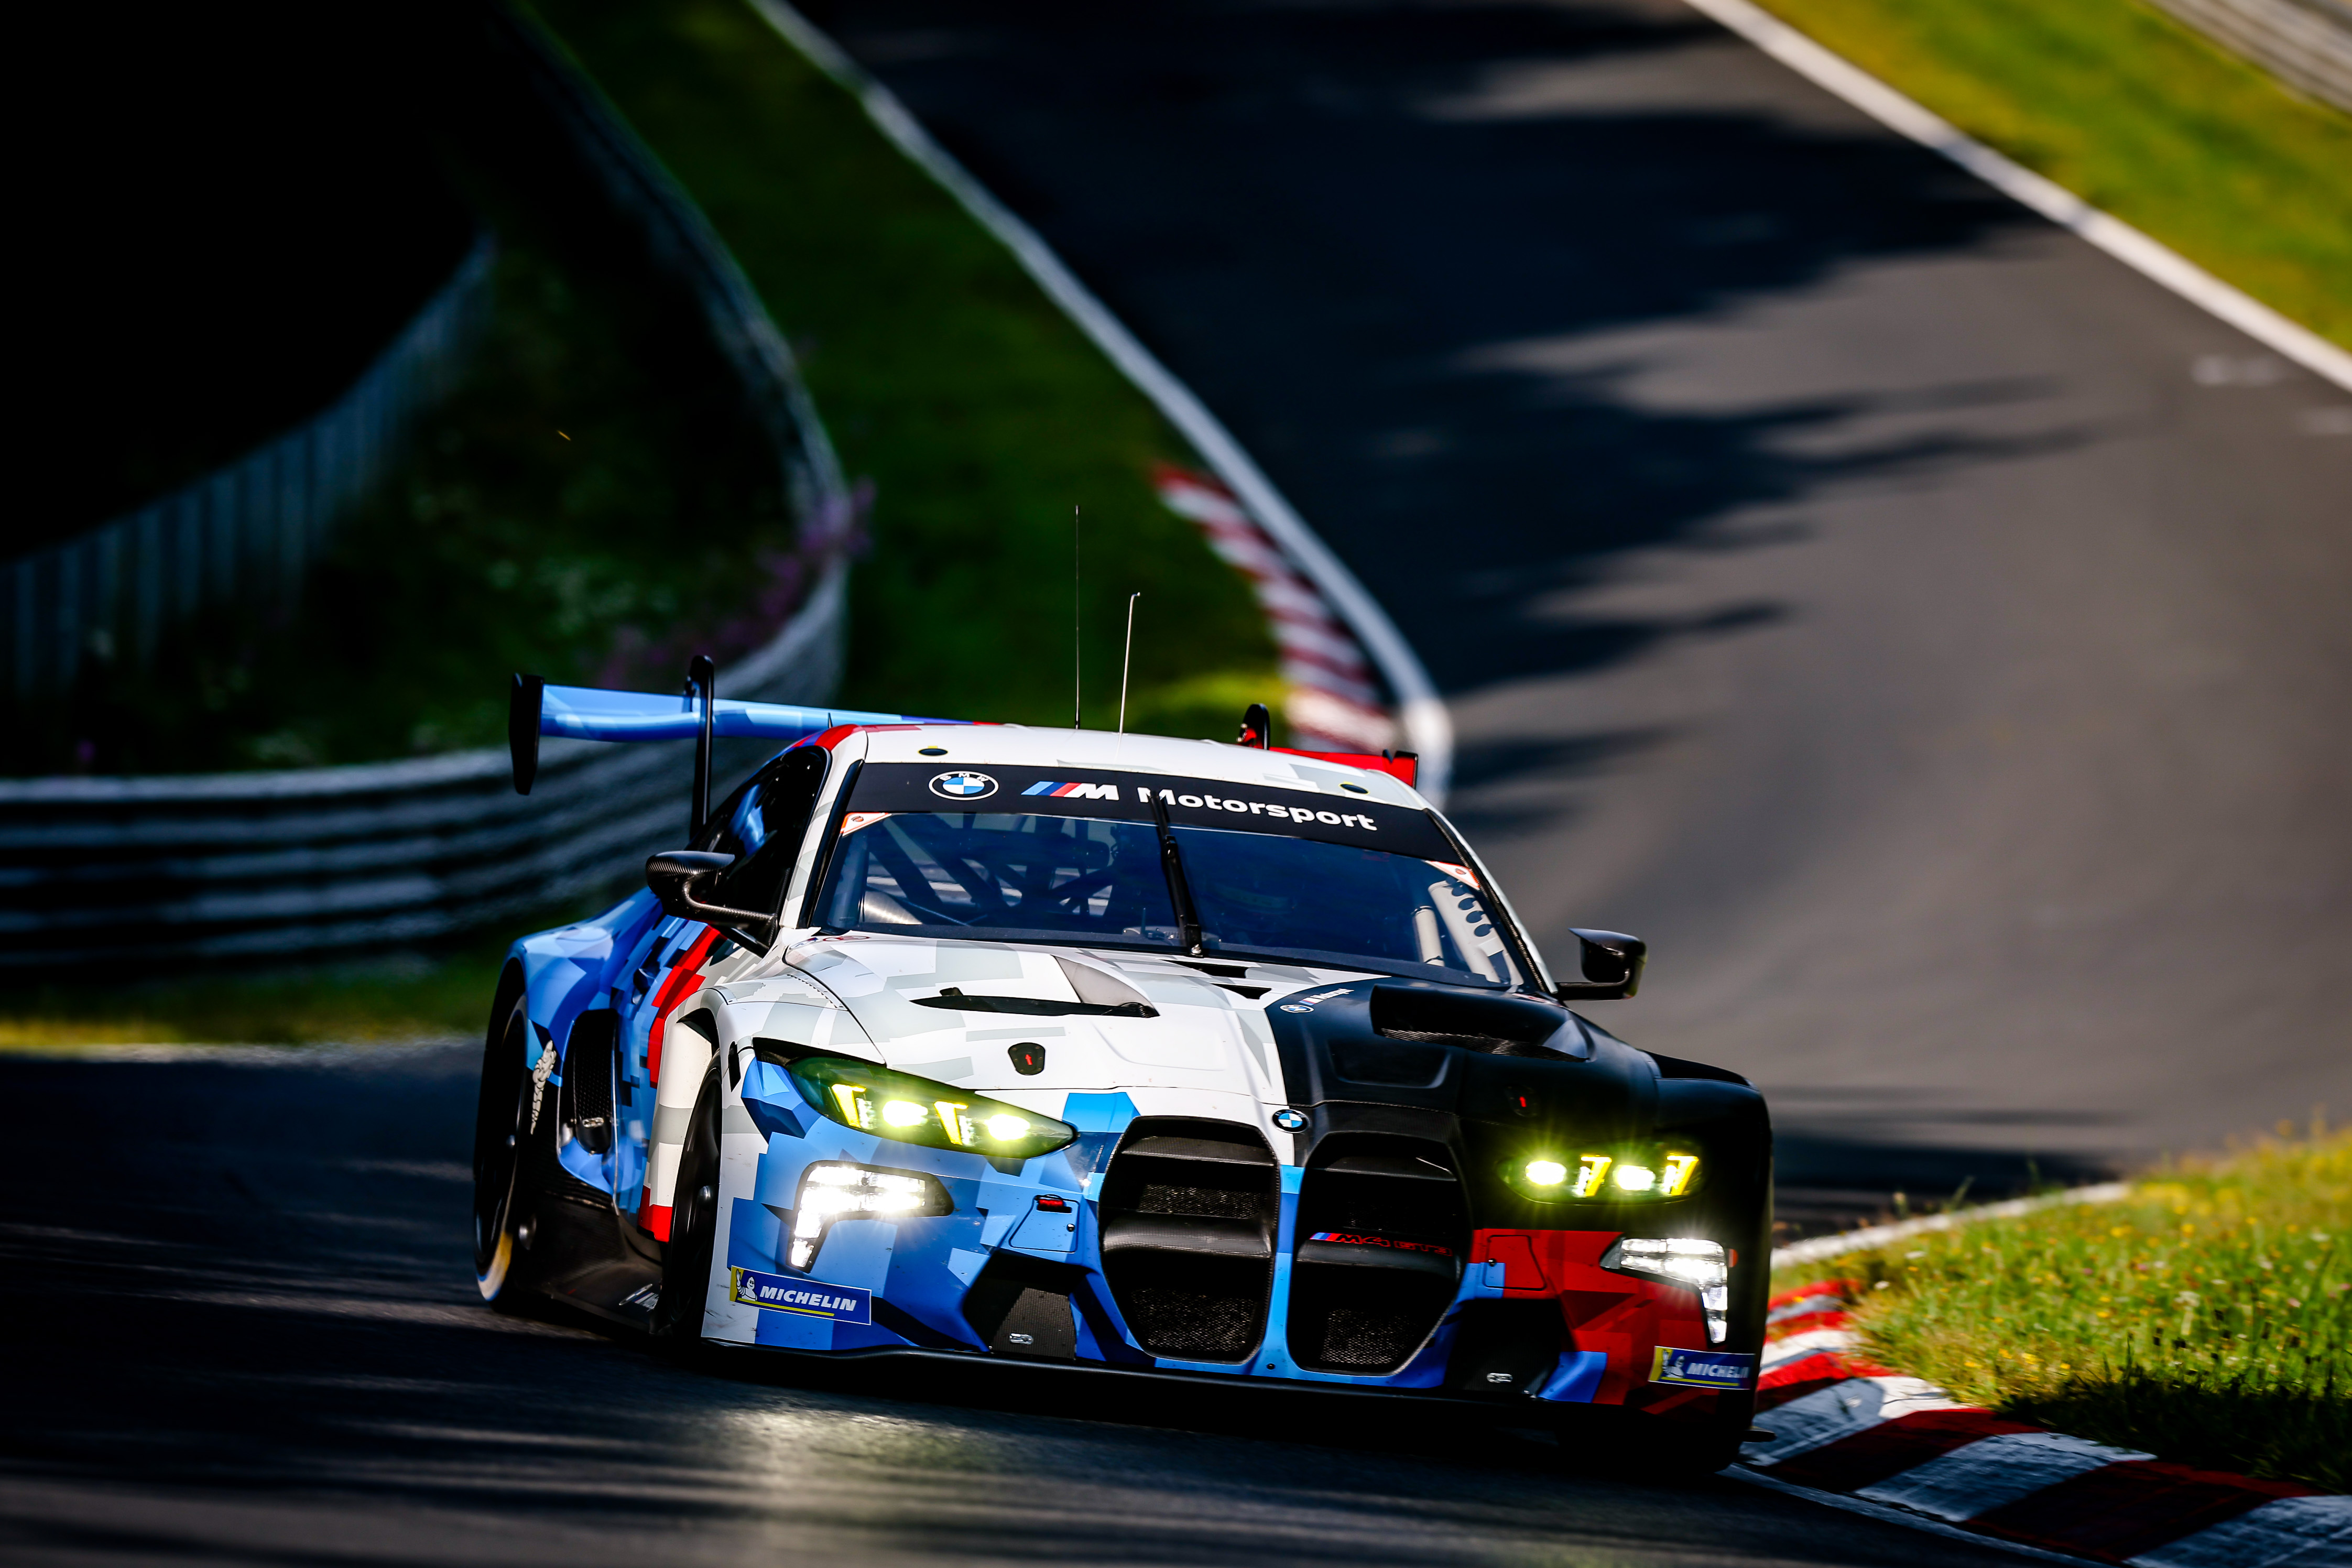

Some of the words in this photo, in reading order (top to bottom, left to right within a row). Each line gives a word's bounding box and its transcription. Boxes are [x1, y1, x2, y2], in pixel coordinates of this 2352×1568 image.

[1137, 787, 1378, 831] Motorsport
[1393, 1240, 1453, 1256] GT3
[759, 1286, 857, 1311] MICHELIN
